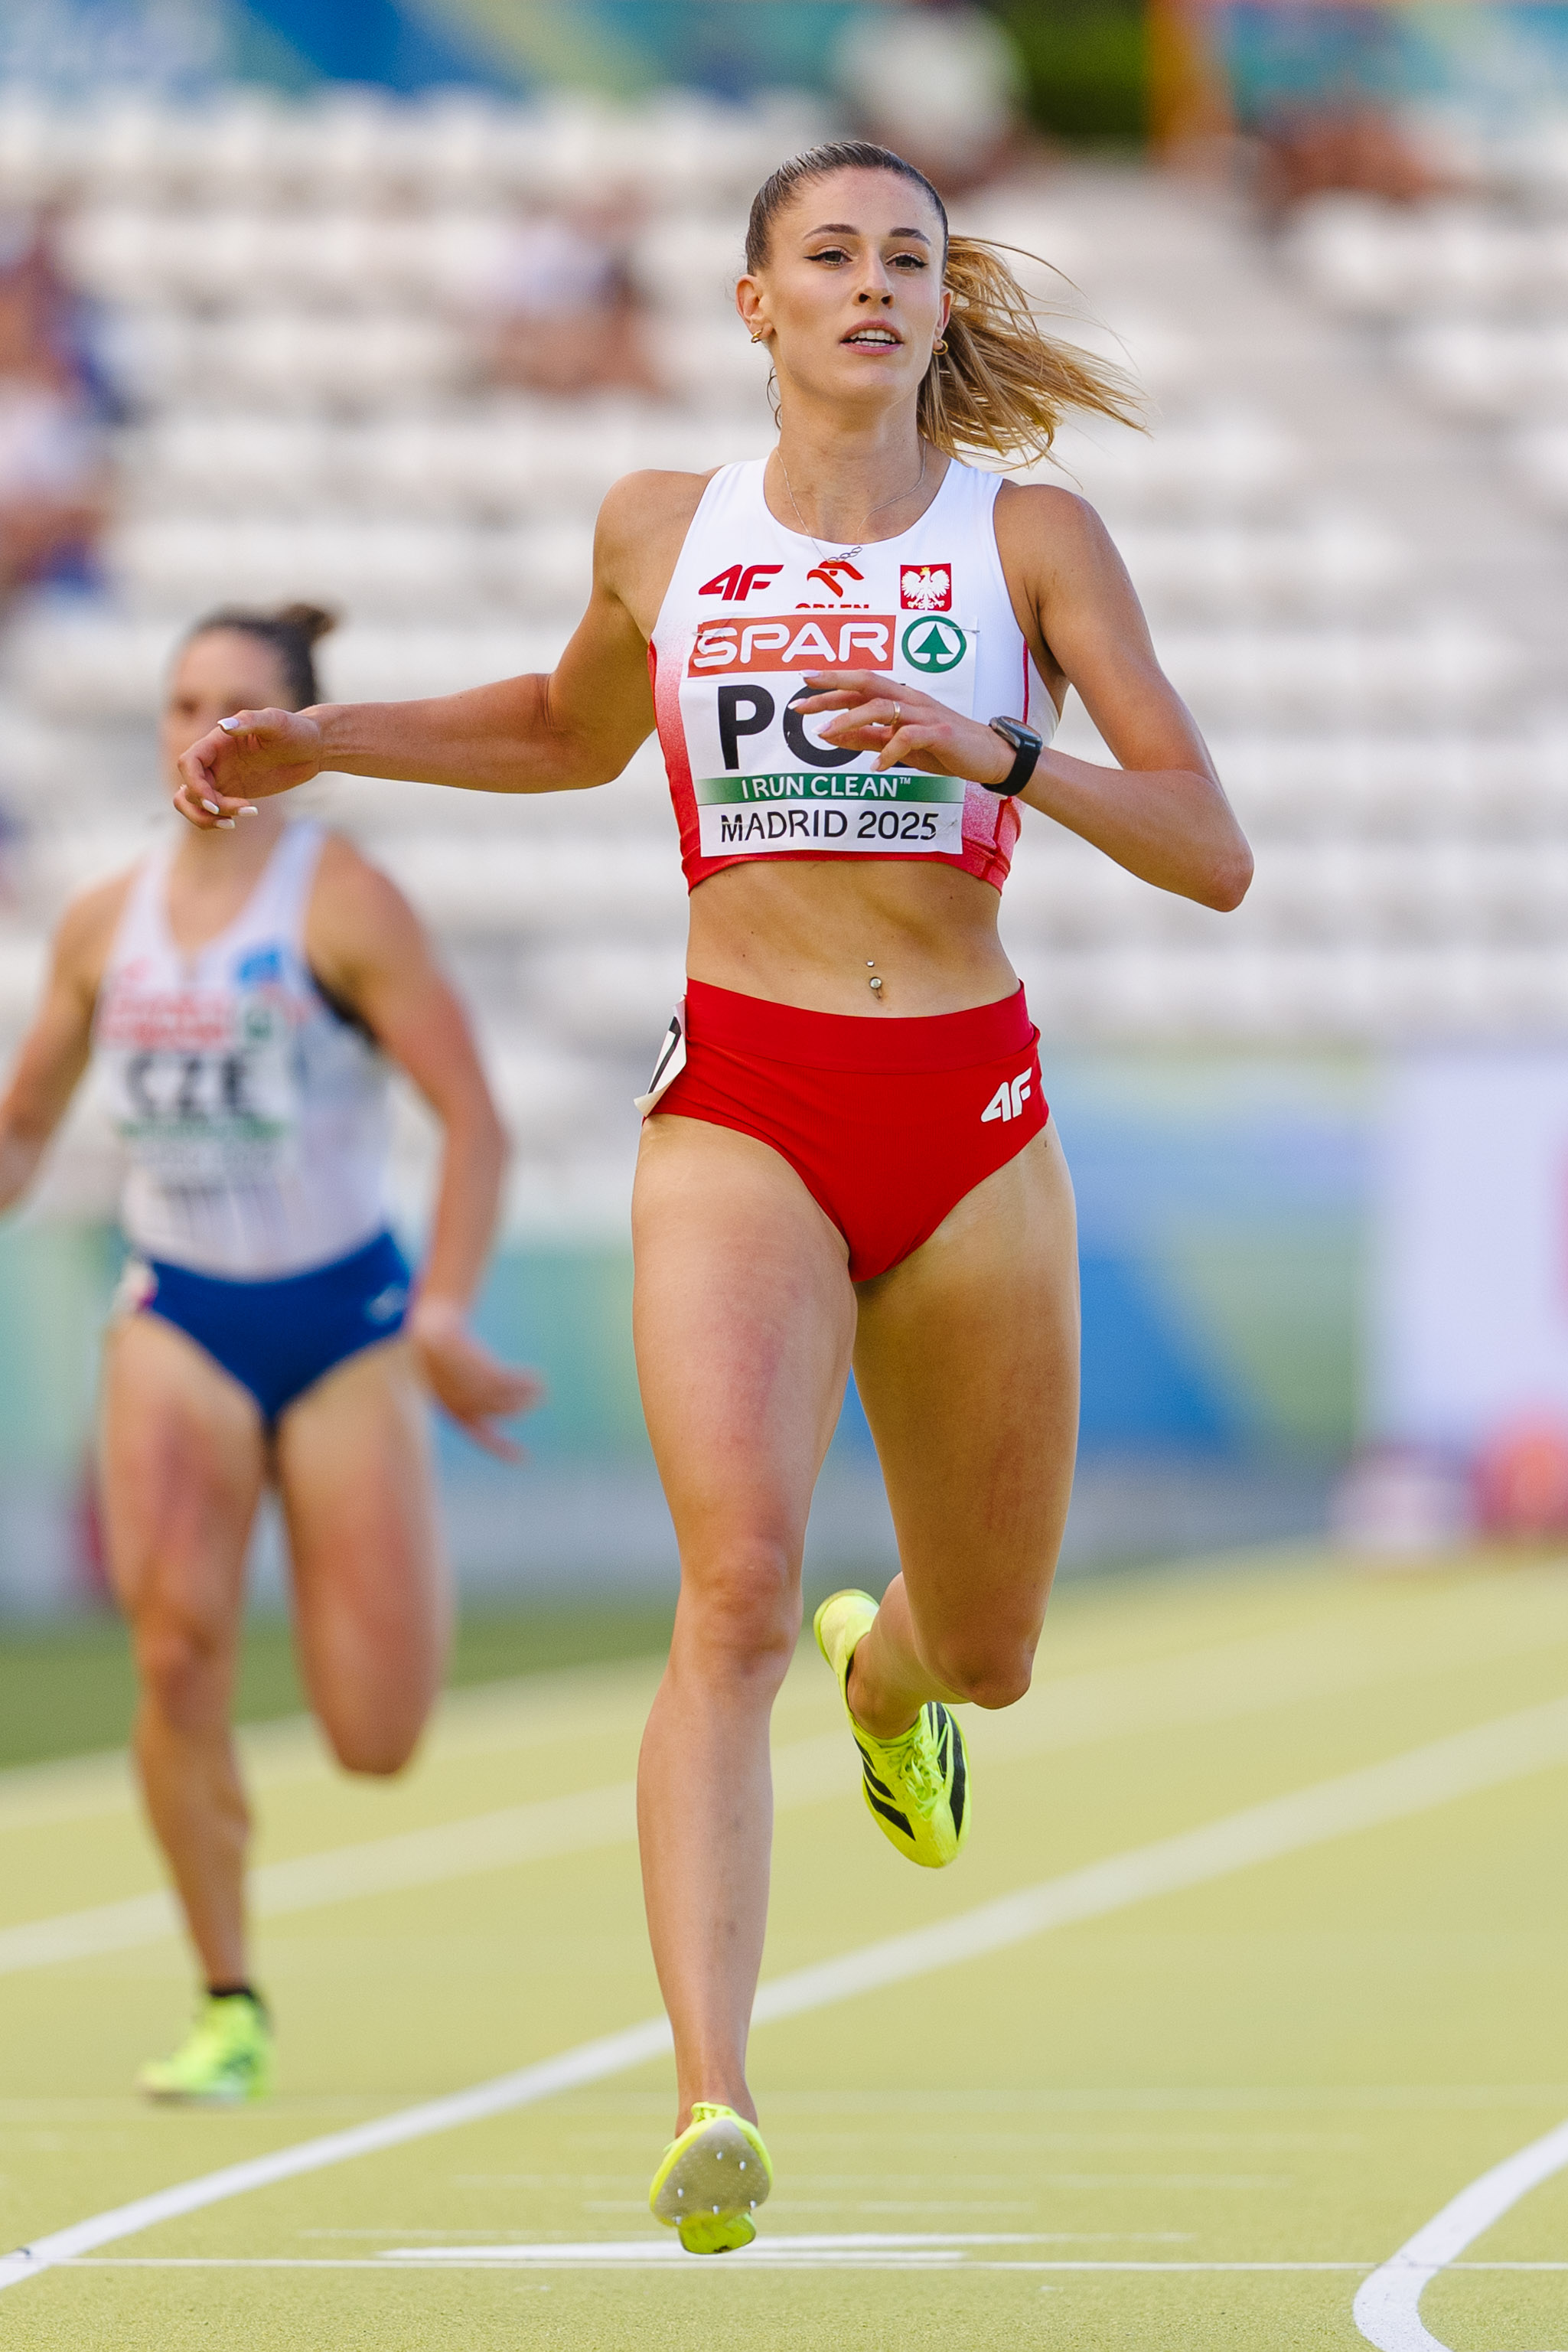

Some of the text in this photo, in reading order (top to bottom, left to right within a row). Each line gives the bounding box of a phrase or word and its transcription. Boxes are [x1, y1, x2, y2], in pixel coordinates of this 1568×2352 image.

[699, 565, 784, 601] 4F
[693, 621, 890, 669] SPAR
[717, 683, 916, 770] PO
[742, 779, 748, 800] I
[752, 776, 804, 798] RUN
[721, 809, 940, 843] MADRID 2025
[980, 1066, 1032, 1123] 4F
